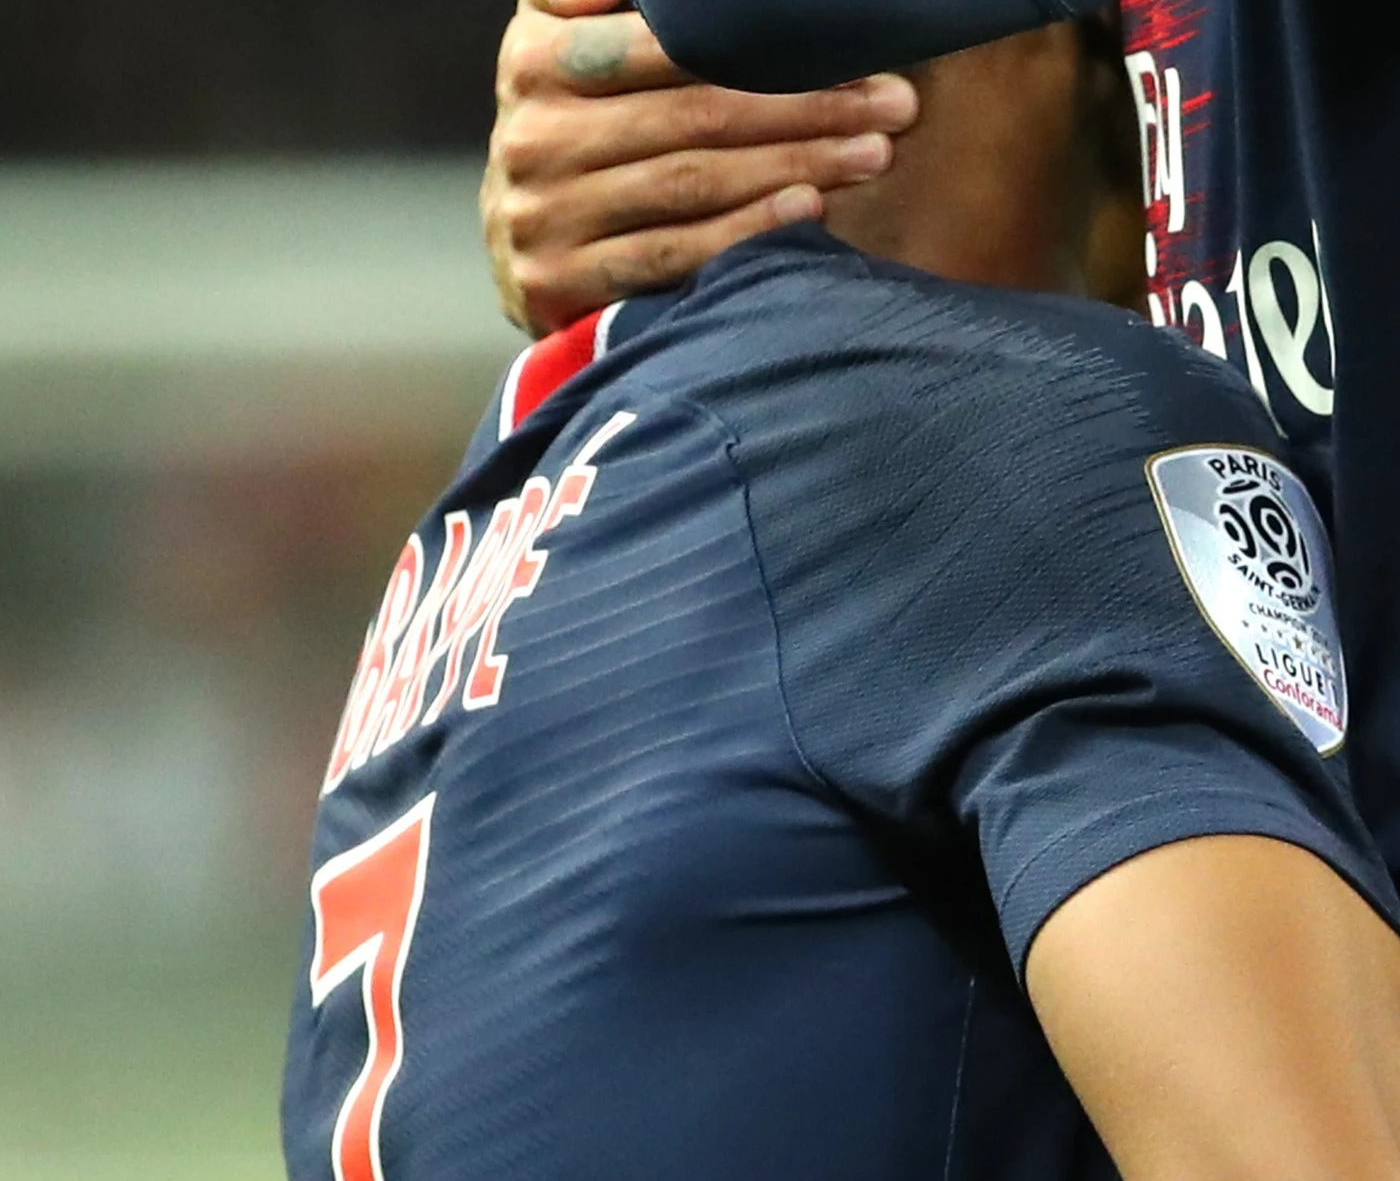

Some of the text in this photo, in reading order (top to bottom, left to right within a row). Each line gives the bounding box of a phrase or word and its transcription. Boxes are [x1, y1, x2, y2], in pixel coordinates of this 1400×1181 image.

[1208, 454, 1282, 492] PARIS
[321, 410, 637, 796] BAPPÉ
[1255, 642, 1325, 696] LIGUE
[1263, 668, 1345, 733] Conforama
[310, 792, 436, 1181] 7
